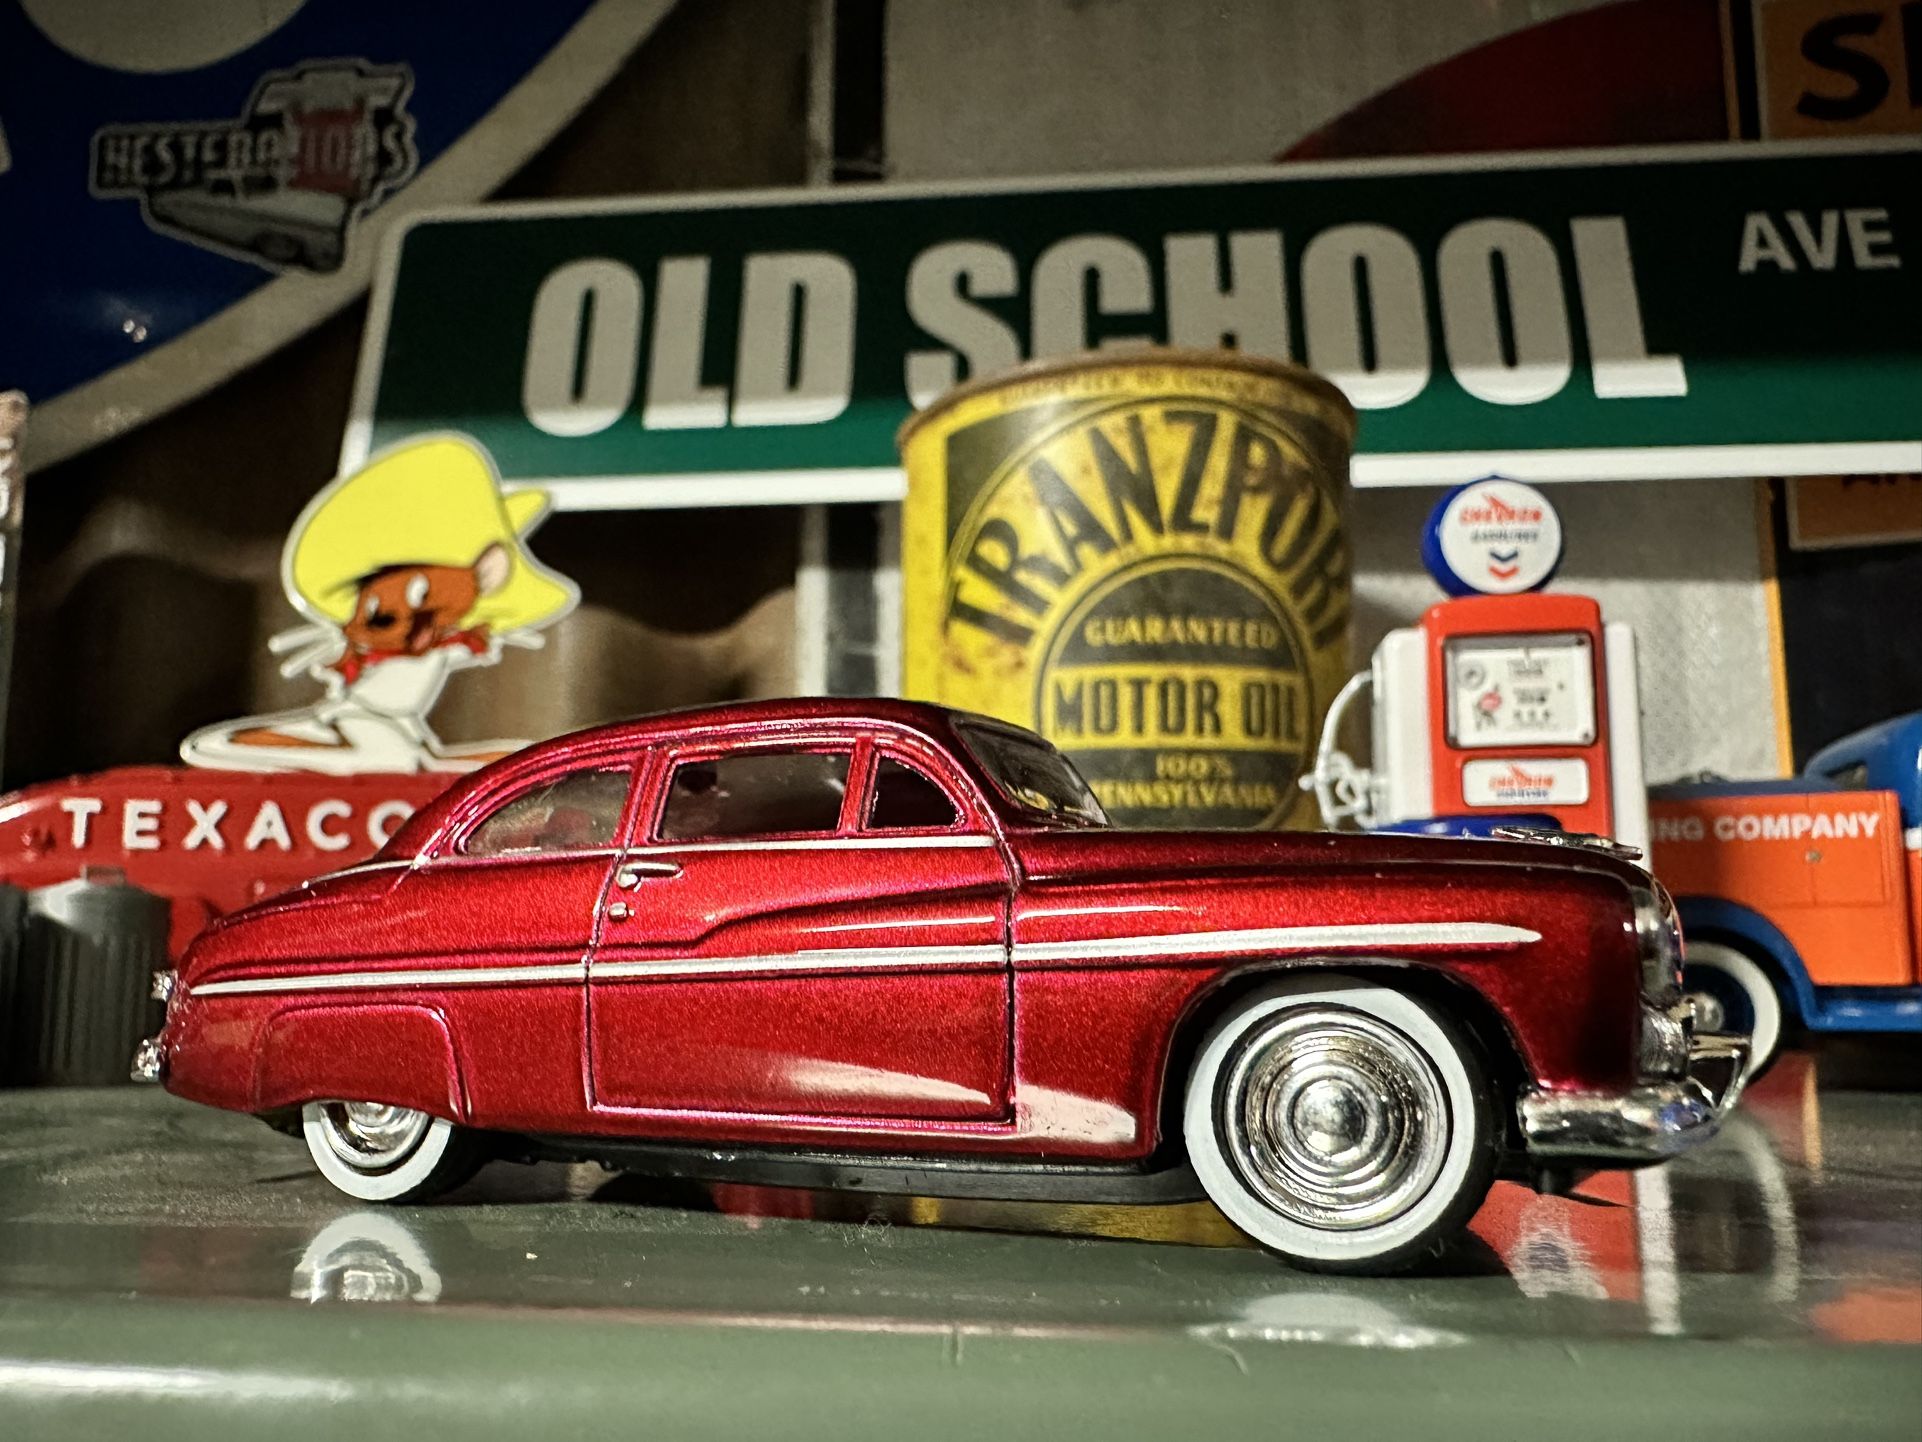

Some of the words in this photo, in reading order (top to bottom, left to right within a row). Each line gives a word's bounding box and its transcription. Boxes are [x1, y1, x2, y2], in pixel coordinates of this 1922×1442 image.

[522, 251, 857, 437] OLD
[904, 216, 1689, 411] SCHOOL
[1738, 208, 1902, 274] AVE
[1083, 614, 1279, 650] GUARANTEED
[1052, 676, 1222, 738] MOTOR
[1241, 682, 1297, 741] OIL
[1714, 812, 1880, 841] COMPANY
